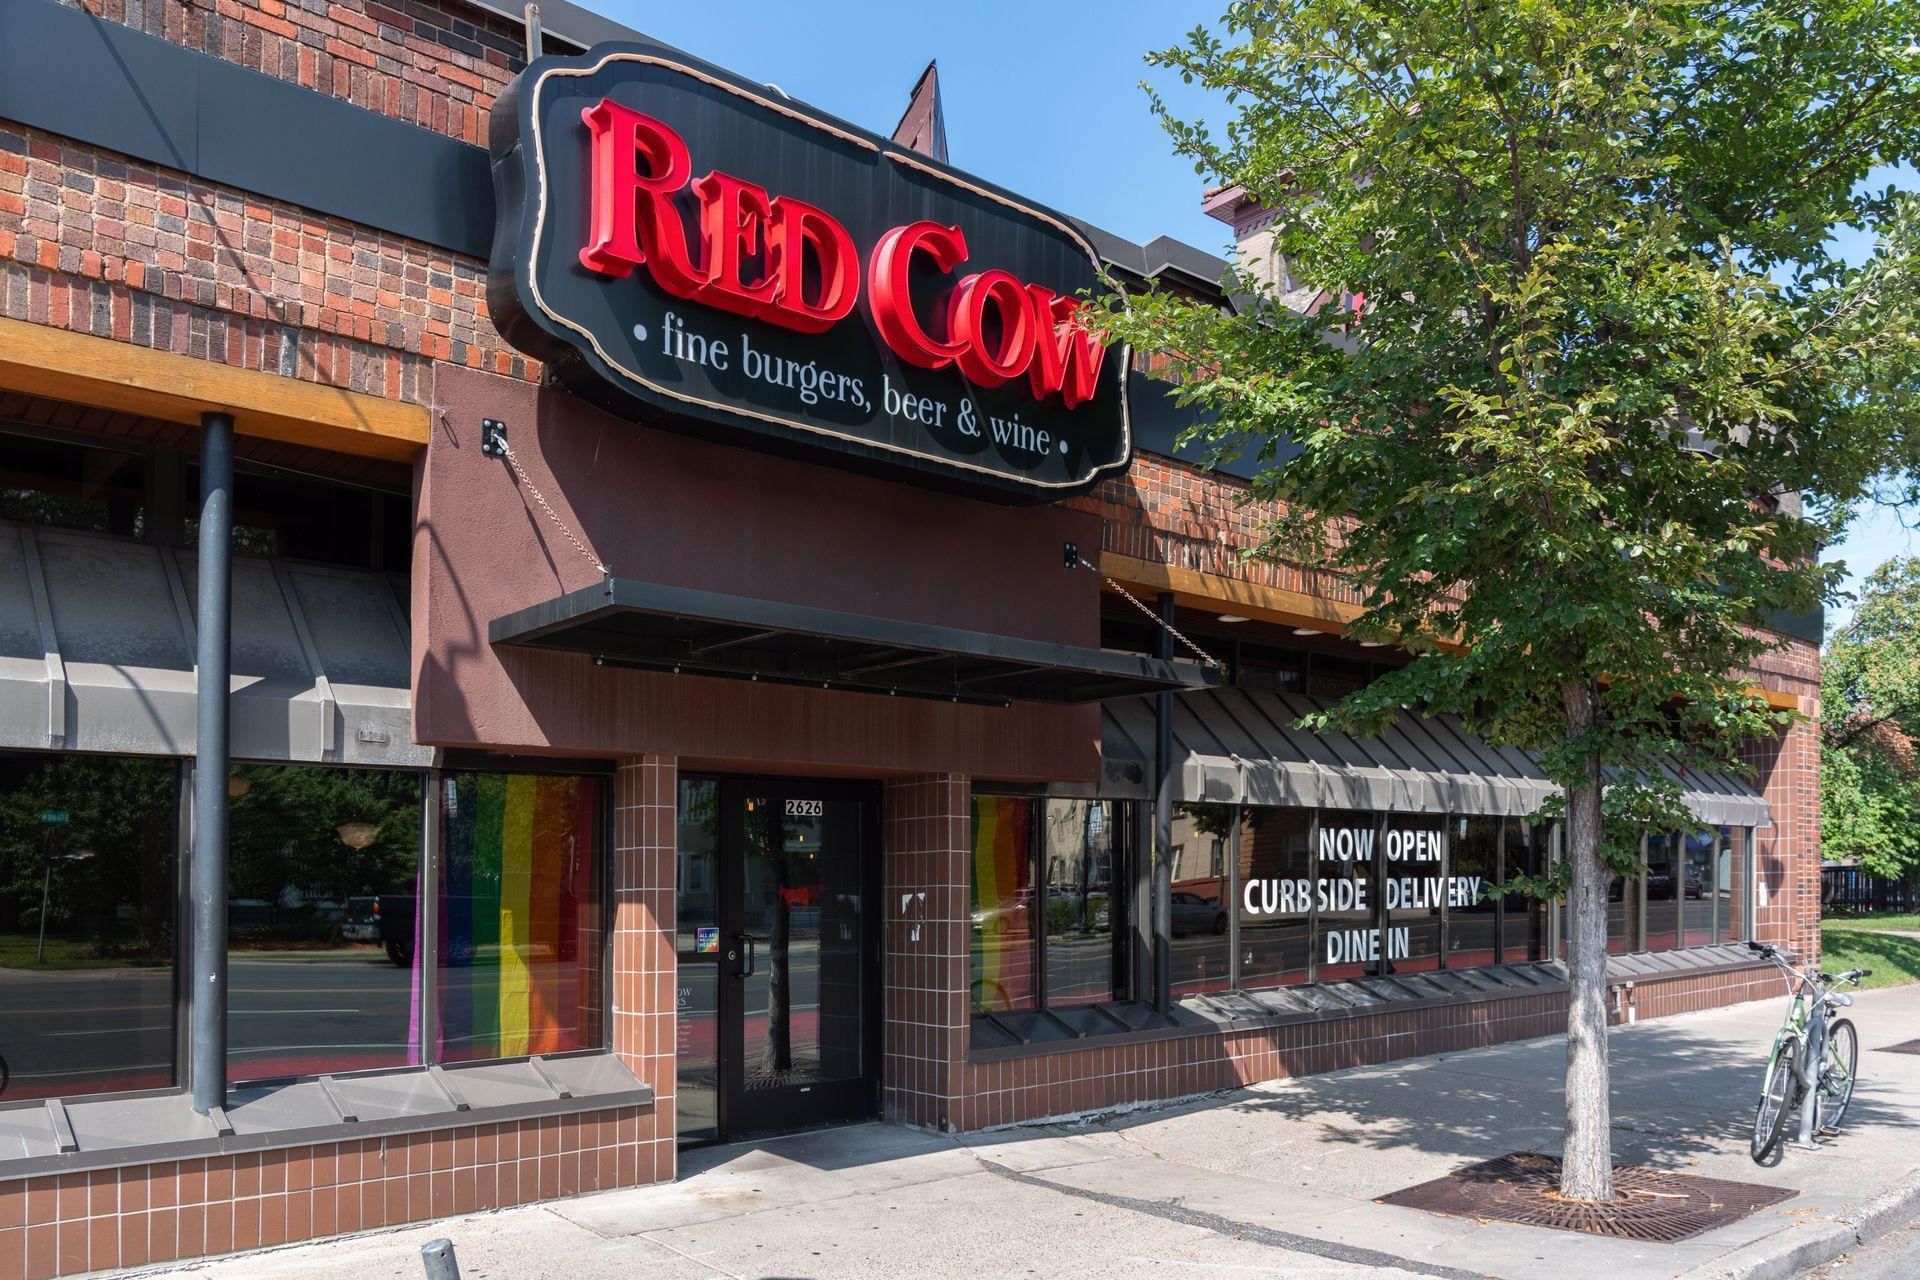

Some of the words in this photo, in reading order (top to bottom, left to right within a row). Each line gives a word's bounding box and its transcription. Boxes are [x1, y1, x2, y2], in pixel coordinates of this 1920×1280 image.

[579, 98, 860, 334] RED
[868, 220, 1110, 409] COW
[661, 311, 728, 371] fine
[741, 333, 871, 413] burgers,
[882, 373, 947, 428] beer
[957, 398, 980, 437] &
[990, 412, 1050, 455] wine
[786, 801, 821, 815] 2626
[1319, 827, 1374, 861] NOW
[1386, 830, 1441, 862] OPEN
[1386, 876, 1481, 909] DELIVERY
[1327, 928, 1380, 964] DINE
[1388, 927, 1409, 959] IN
